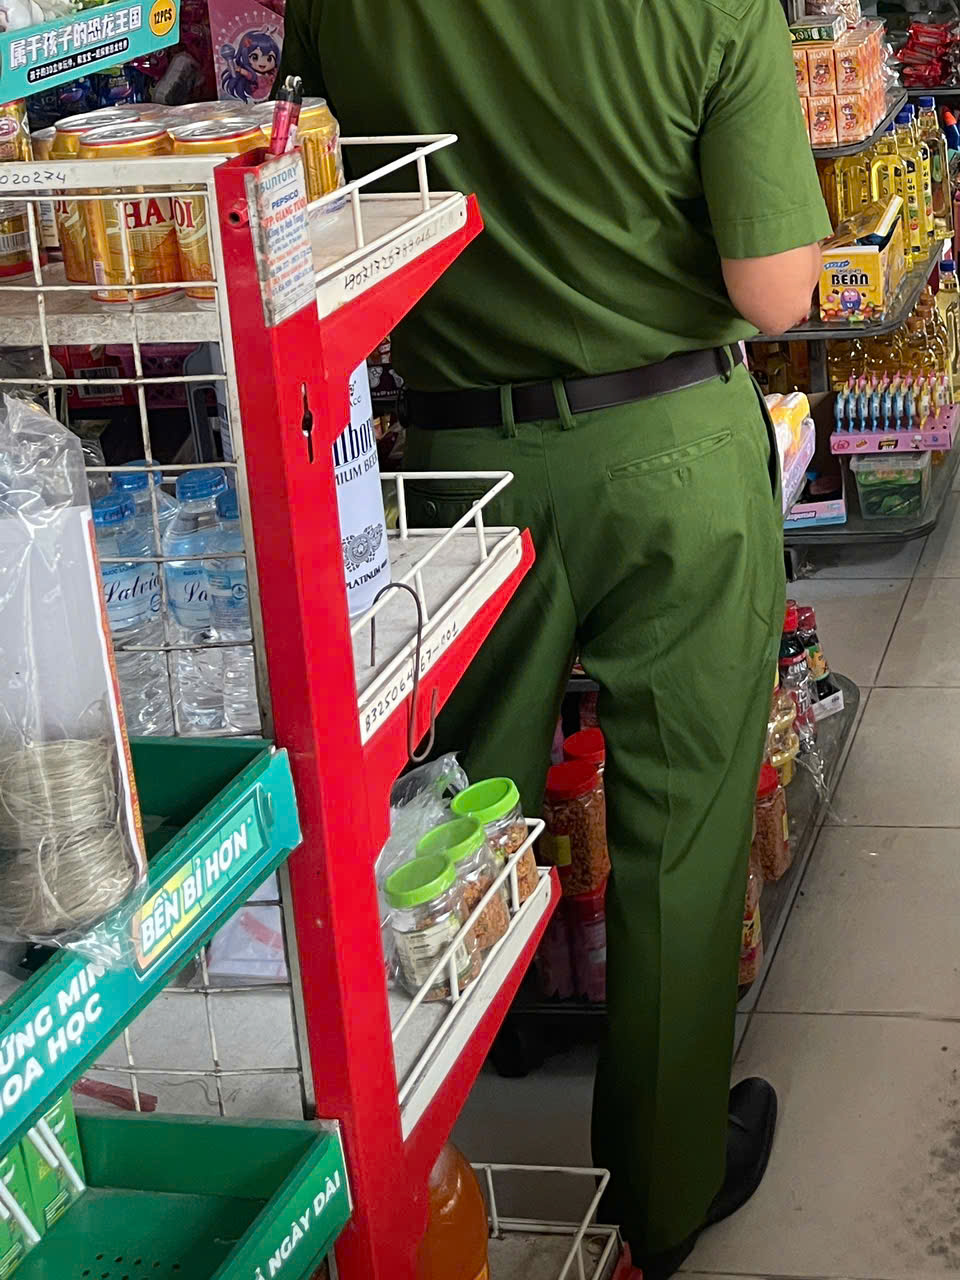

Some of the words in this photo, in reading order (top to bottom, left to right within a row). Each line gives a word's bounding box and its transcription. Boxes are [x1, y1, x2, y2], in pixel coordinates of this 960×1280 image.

[153, 8, 173, 26] 12PCS
[271, 189, 299, 210] PEPSICO
[831, 274, 869, 285] BEAN
[140, 889, 180, 950] BỀN
[183, 858, 204, 912] BỈ
[205, 823, 249, 887] HƠN
[0, 1013, 54, 1071] ỨNG
[57, 960, 113, 1016] MIN
[0, 1061, 45, 1116] OA
[48, 992, 103, 1064] HỌC
[267, 1207, 311, 1278] NGÀY
[313, 1170, 341, 1217] DÀI
